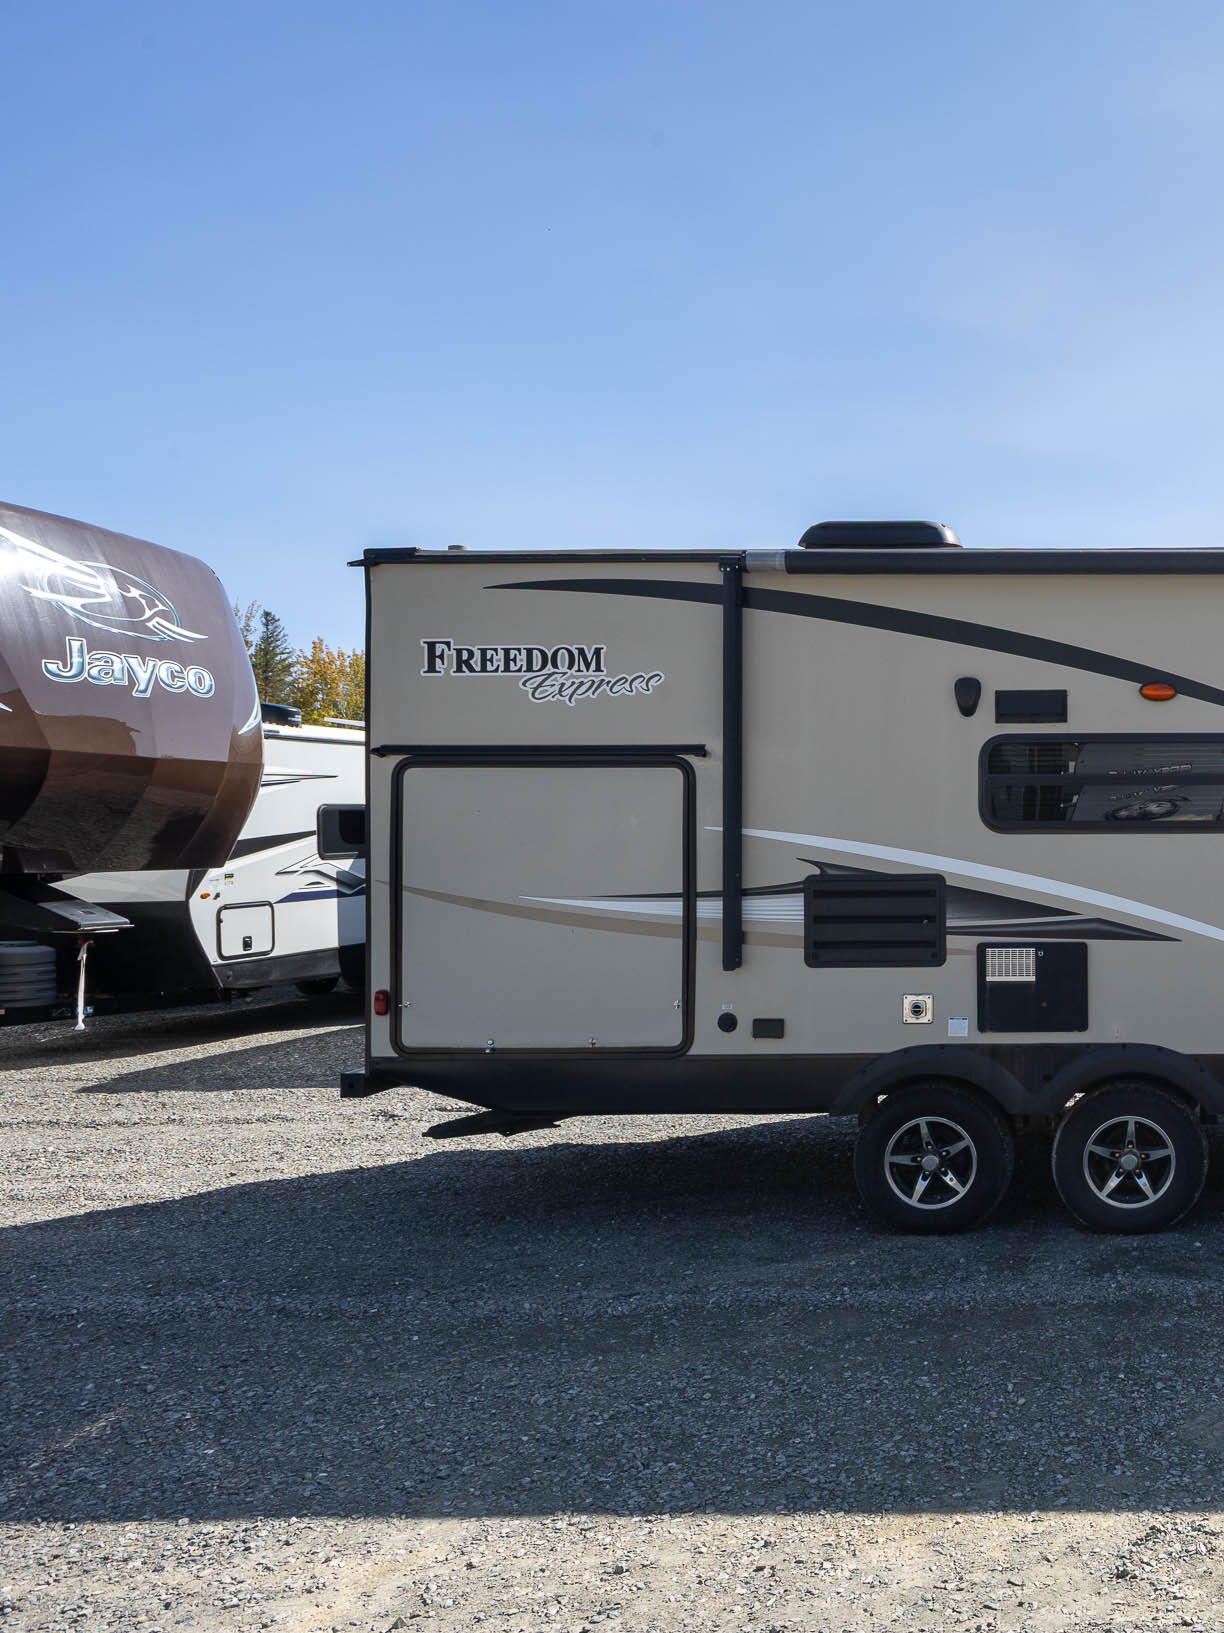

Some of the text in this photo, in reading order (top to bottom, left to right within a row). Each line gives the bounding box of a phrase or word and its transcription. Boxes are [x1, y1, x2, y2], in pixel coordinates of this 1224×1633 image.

[42, 636, 215, 698] Jayco
[421, 639, 606, 675] FREEDOM
[520, 671, 664, 705] Express
